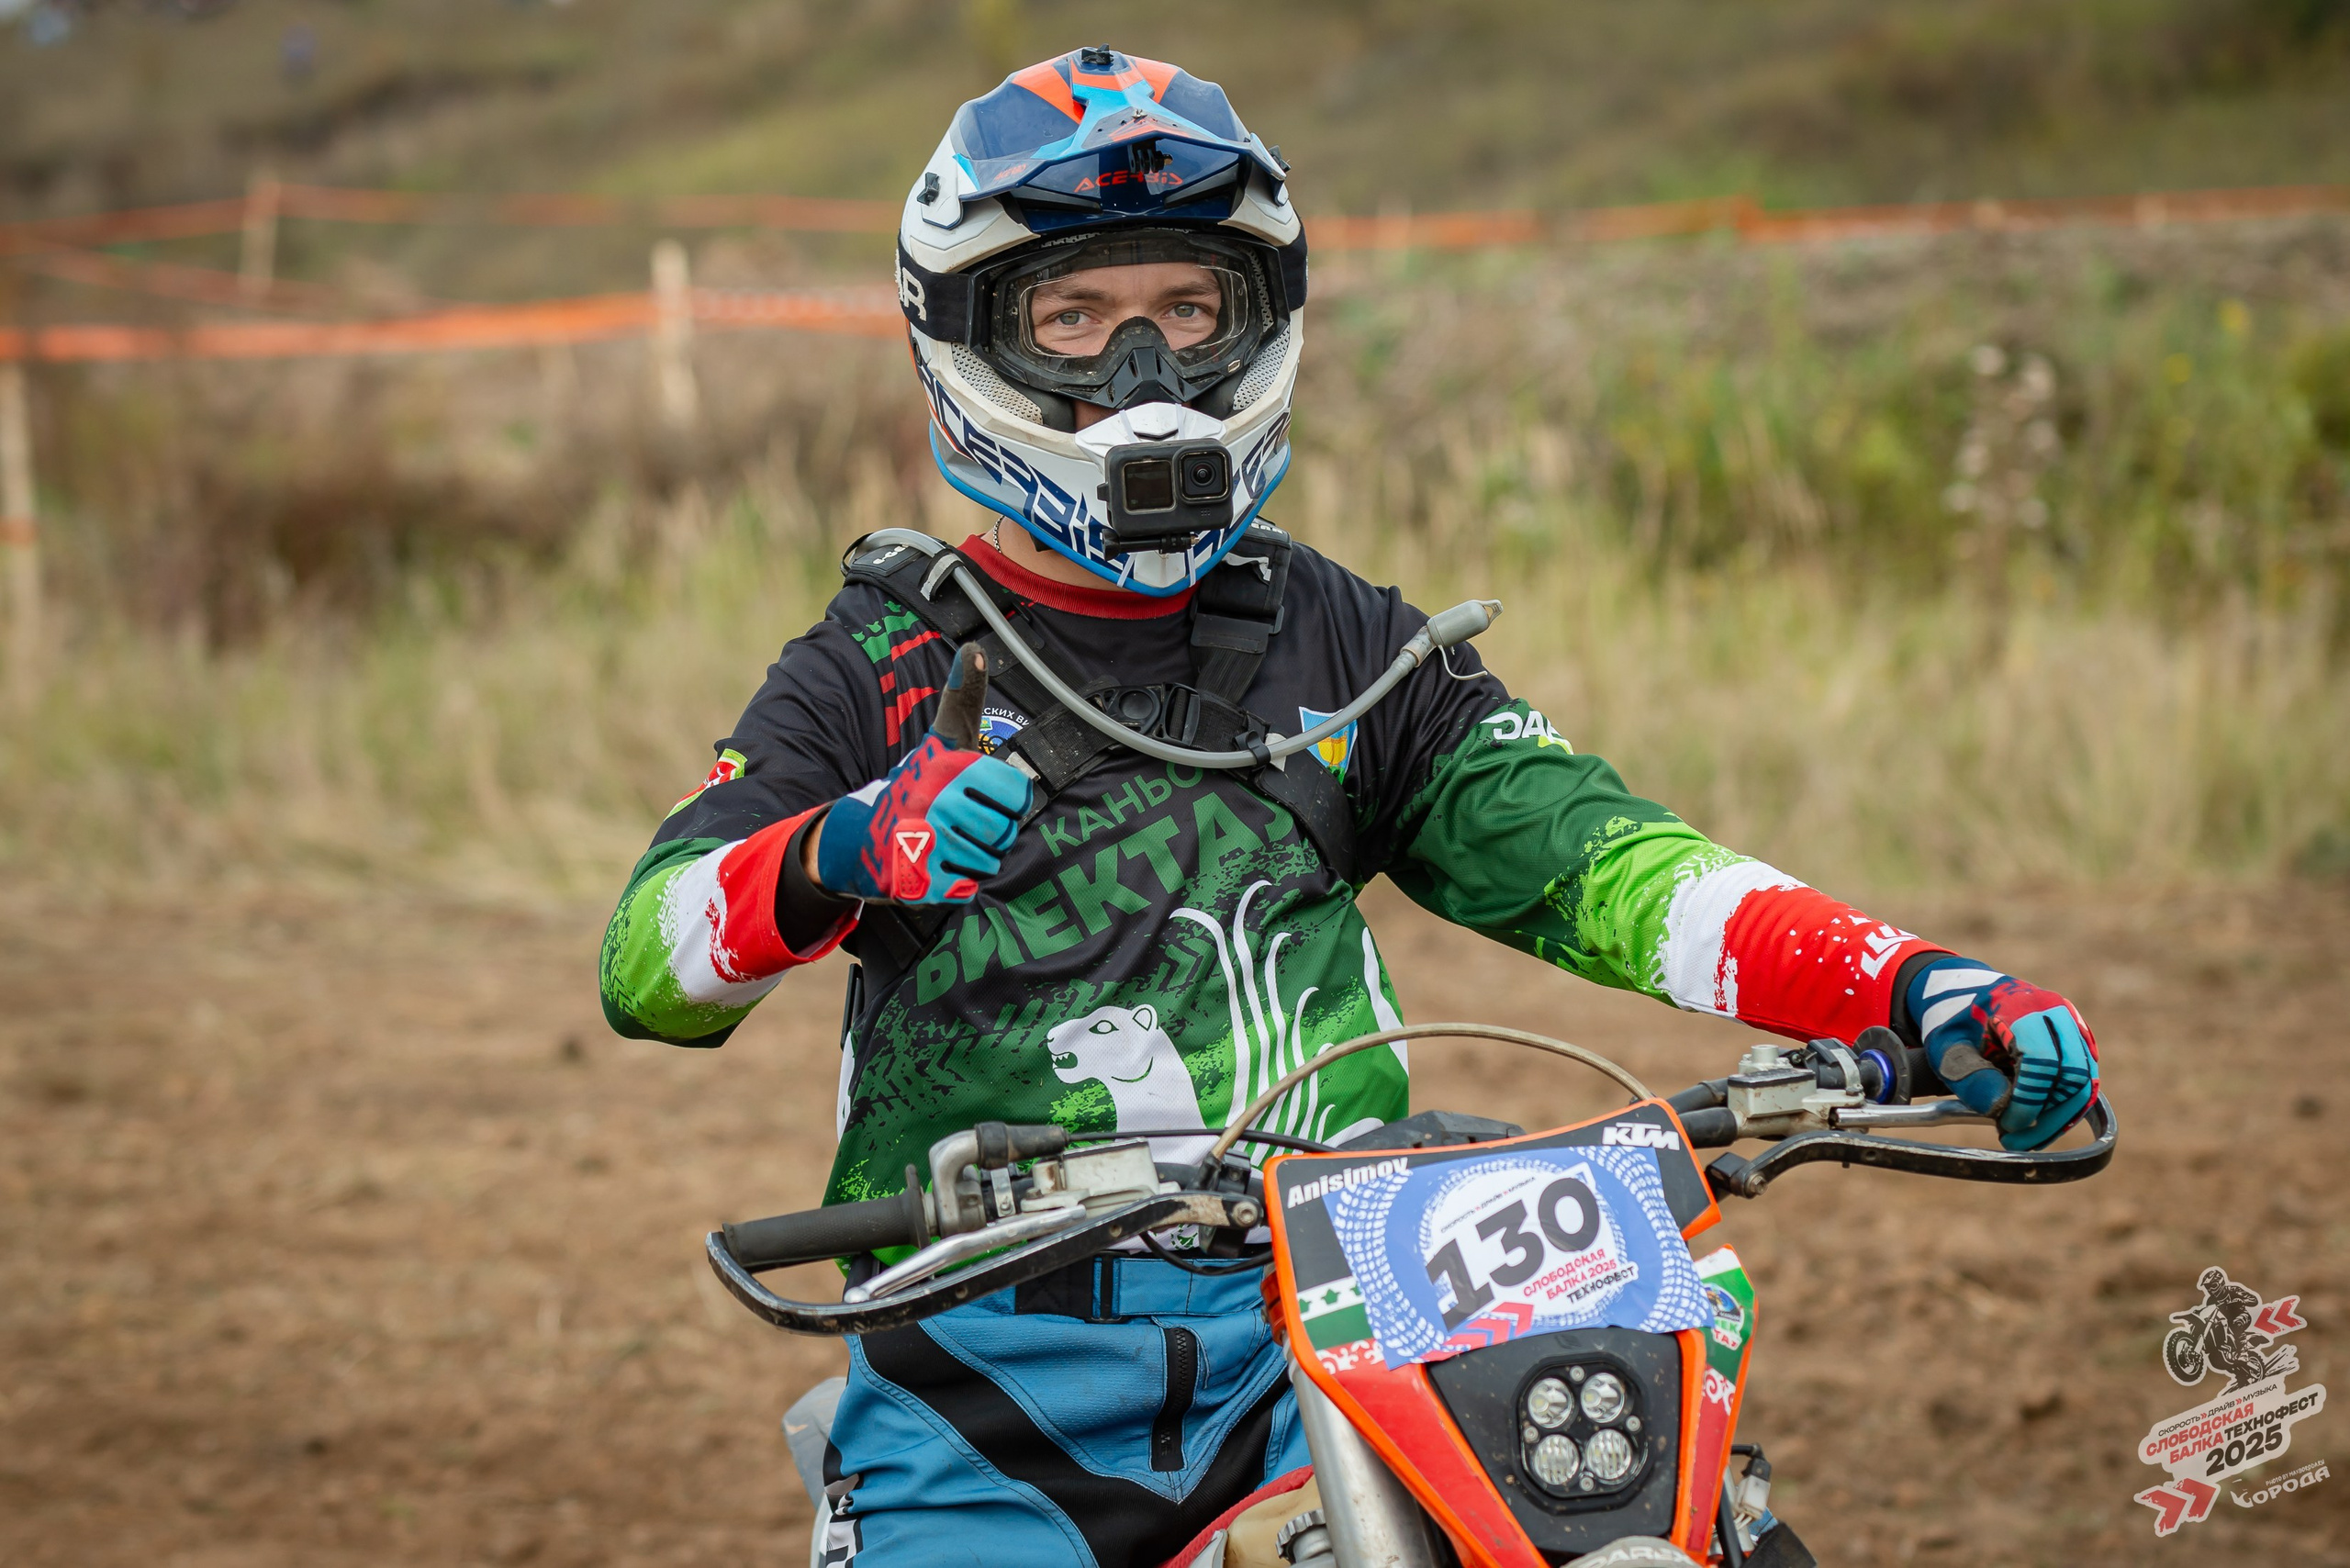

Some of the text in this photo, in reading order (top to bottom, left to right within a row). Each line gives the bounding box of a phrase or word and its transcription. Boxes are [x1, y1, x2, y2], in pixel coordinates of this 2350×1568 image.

[982, 707, 1015, 720] СКИХ
[1038, 761, 1205, 858] КАНЬО
[1602, 1122, 1680, 1151] KTM
[1287, 1157, 1409, 1209] Anisimov
[1426, 1177, 1600, 1333] 130
[1523, 1248, 1606, 1297] СЛОБОДСКАЯ
[1546, 1259, 1617, 1300] БАЛКА 2025
[1566, 1266, 1634, 1304] ТЕХНОФЕСТ
